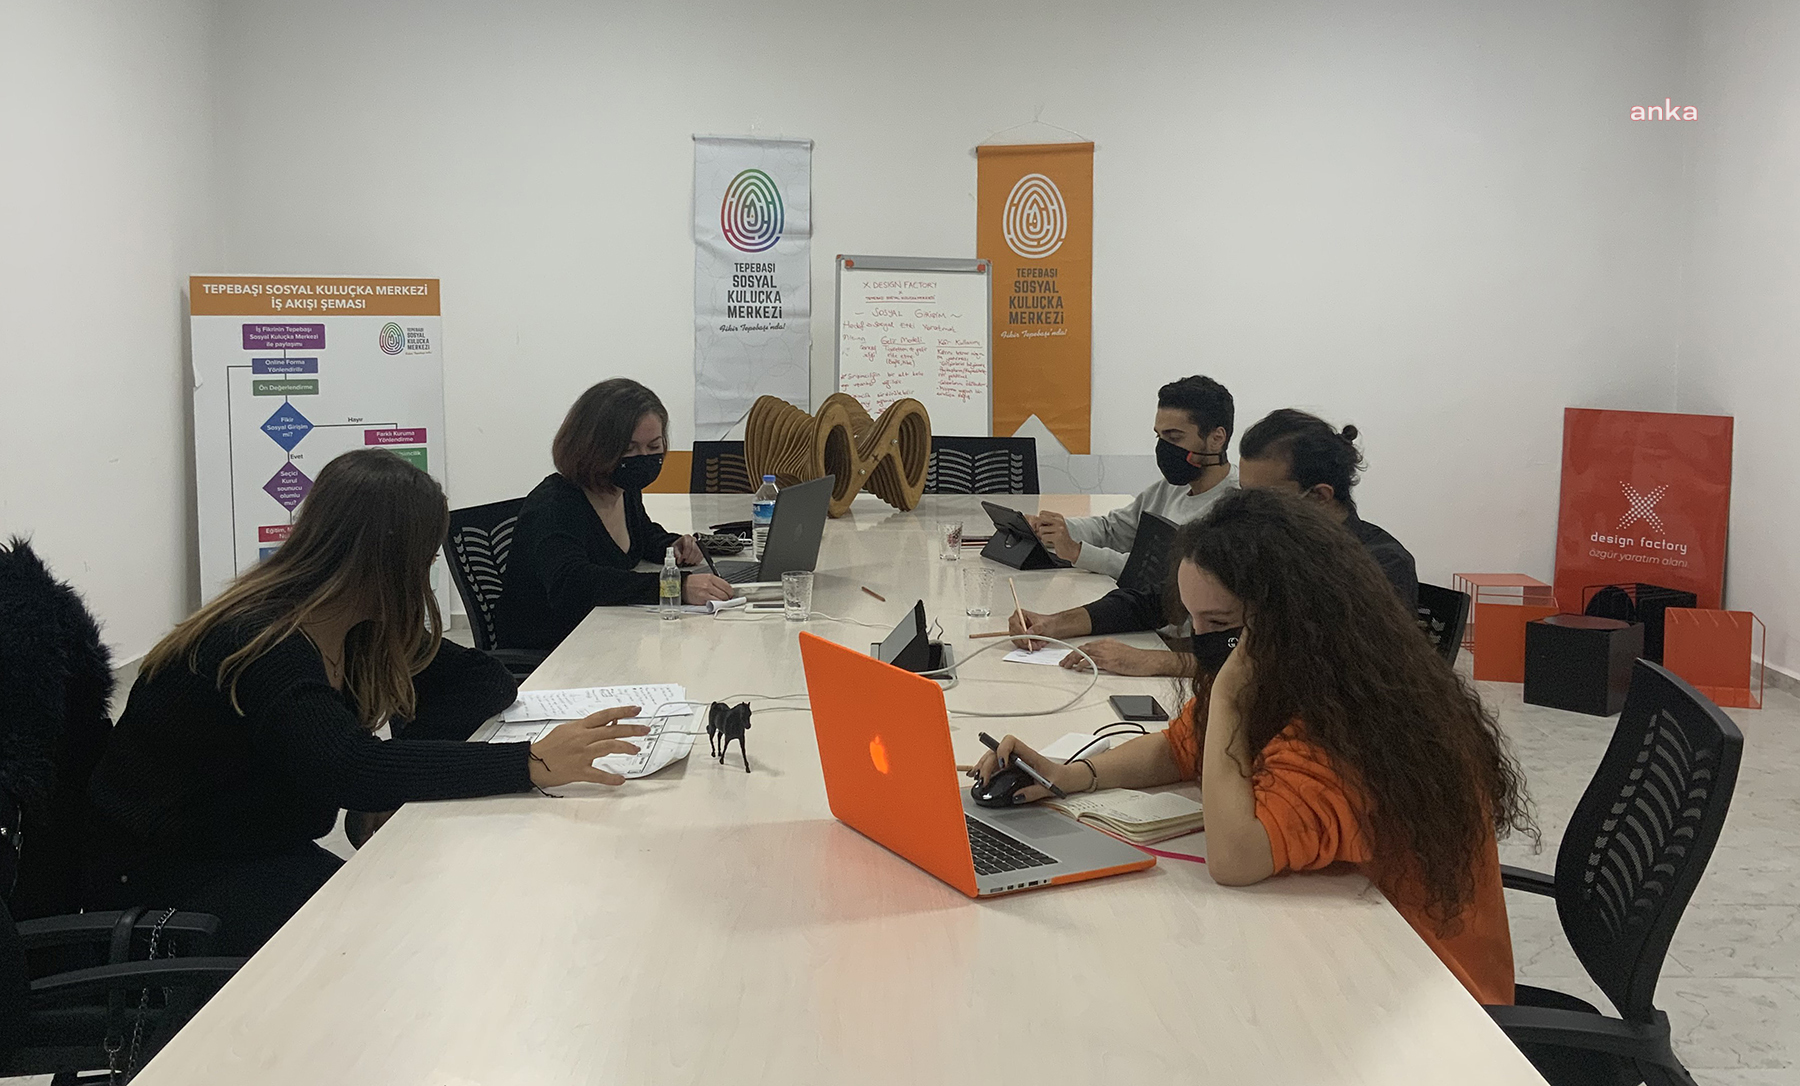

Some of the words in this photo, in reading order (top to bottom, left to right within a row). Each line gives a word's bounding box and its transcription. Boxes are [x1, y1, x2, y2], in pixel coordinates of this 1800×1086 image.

[733, 262, 776, 273] TEPEBAŞI
[1016, 268, 1058, 278] TEPEBAŞI
[732, 274, 777, 288] SOSYAL
[873, 281, 901, 289] DESIGN
[903, 281, 938, 289] FACTORY
[1014, 280, 1059, 294] SOSYAL
[202, 284, 263, 297] TEPEBAŞI
[265, 284, 314, 295] SOSYAL
[316, 285, 374, 298] KULUÇKA
[375, 284, 428, 296] MERKEZİ
[727, 290, 782, 304] KULUÇKA
[271, 296, 283, 311] İŞ
[284, 299, 318, 311] AKIŞI
[320, 299, 366, 311] ŞEMASI
[1009, 296, 1064, 310] KULUÇKA
[872, 307, 903, 318] SOSYAL
[1590, 531, 1635, 549] design
[1639, 536, 1688, 556] factory
[1588, 547, 1619, 560] özgür
[1618, 552, 1661, 564] yaratım
[1661, 556, 1689, 569] alanı
